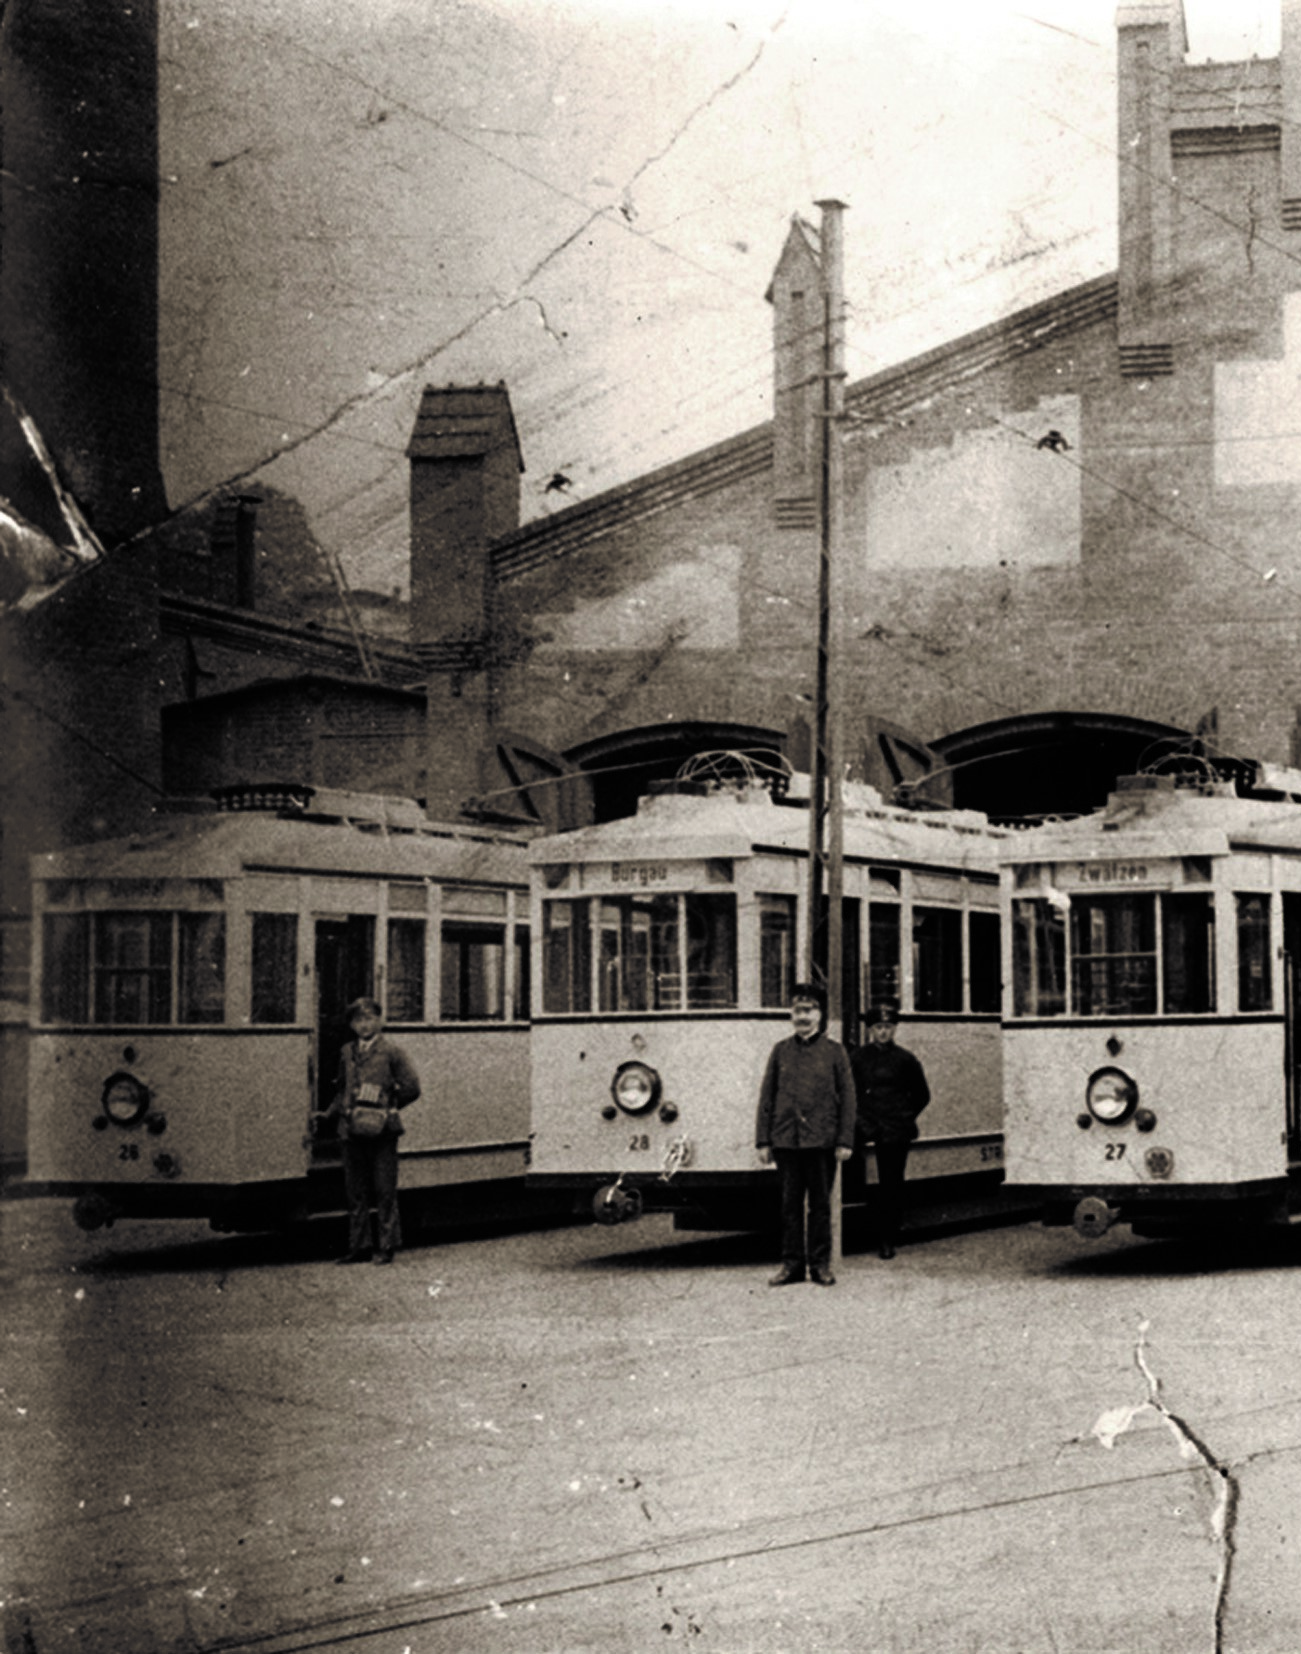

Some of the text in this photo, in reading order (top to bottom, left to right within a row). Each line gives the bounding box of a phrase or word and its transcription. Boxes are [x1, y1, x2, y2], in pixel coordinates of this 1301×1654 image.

[611, 861, 668, 886] Burgau
[629, 1133, 649, 1151] 28
[1105, 1143, 1127, 1161] 27
